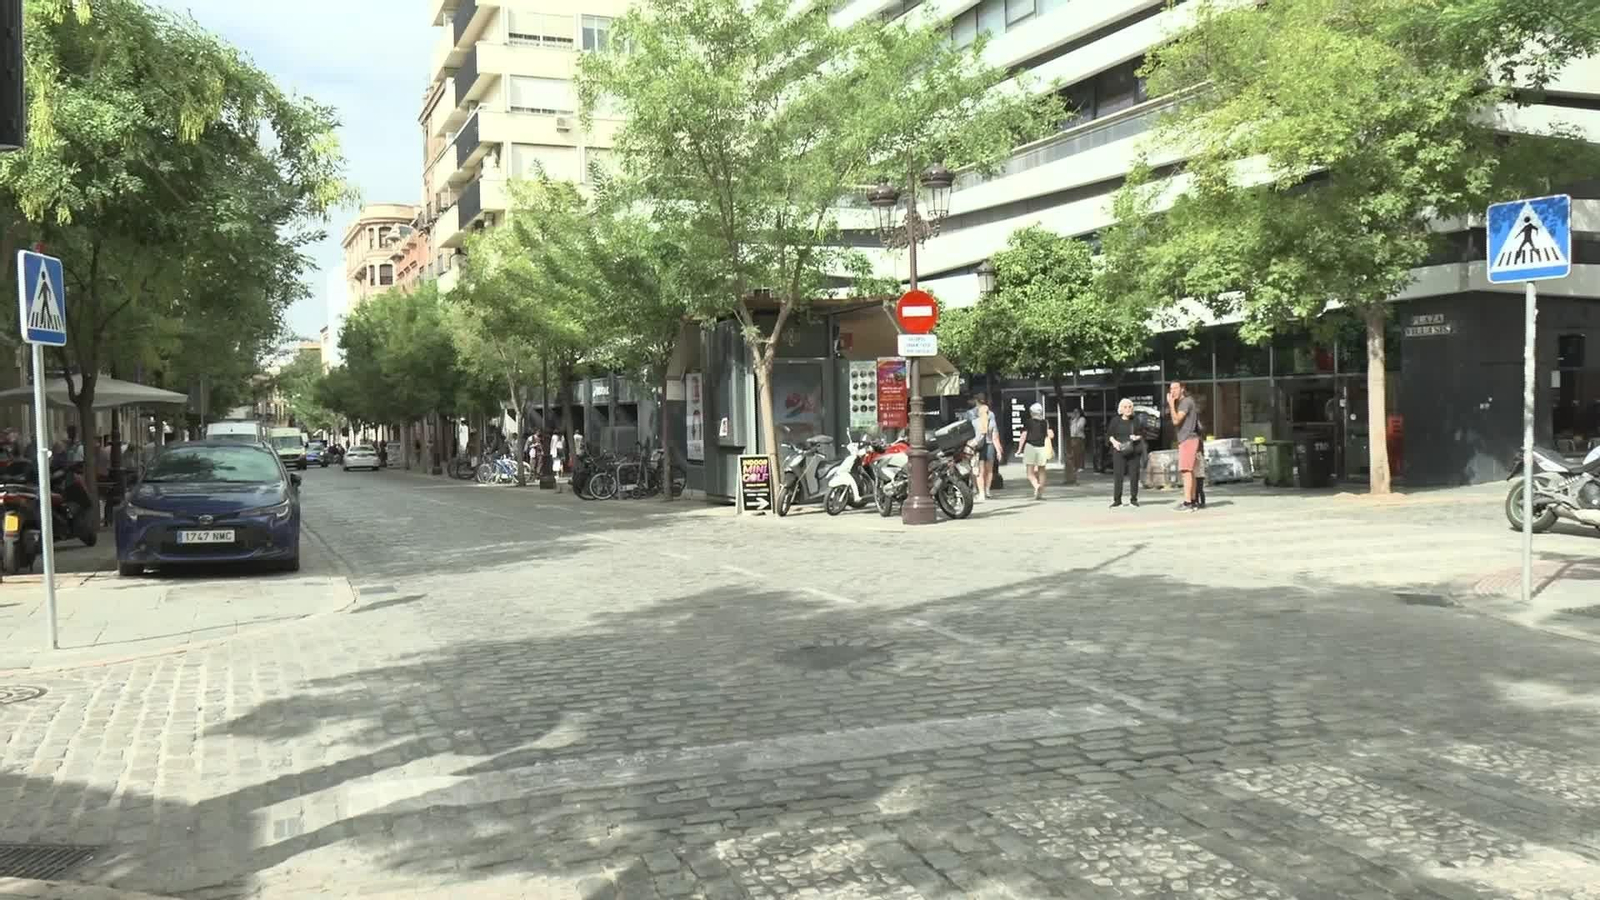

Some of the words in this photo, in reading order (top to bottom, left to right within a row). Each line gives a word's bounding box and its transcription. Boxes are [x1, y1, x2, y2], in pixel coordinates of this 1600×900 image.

[743, 465, 768, 474] MINI
[743, 473, 769, 482] GOLF
[186, 532, 210, 541] 1747
[213, 531, 232, 541] NMC
